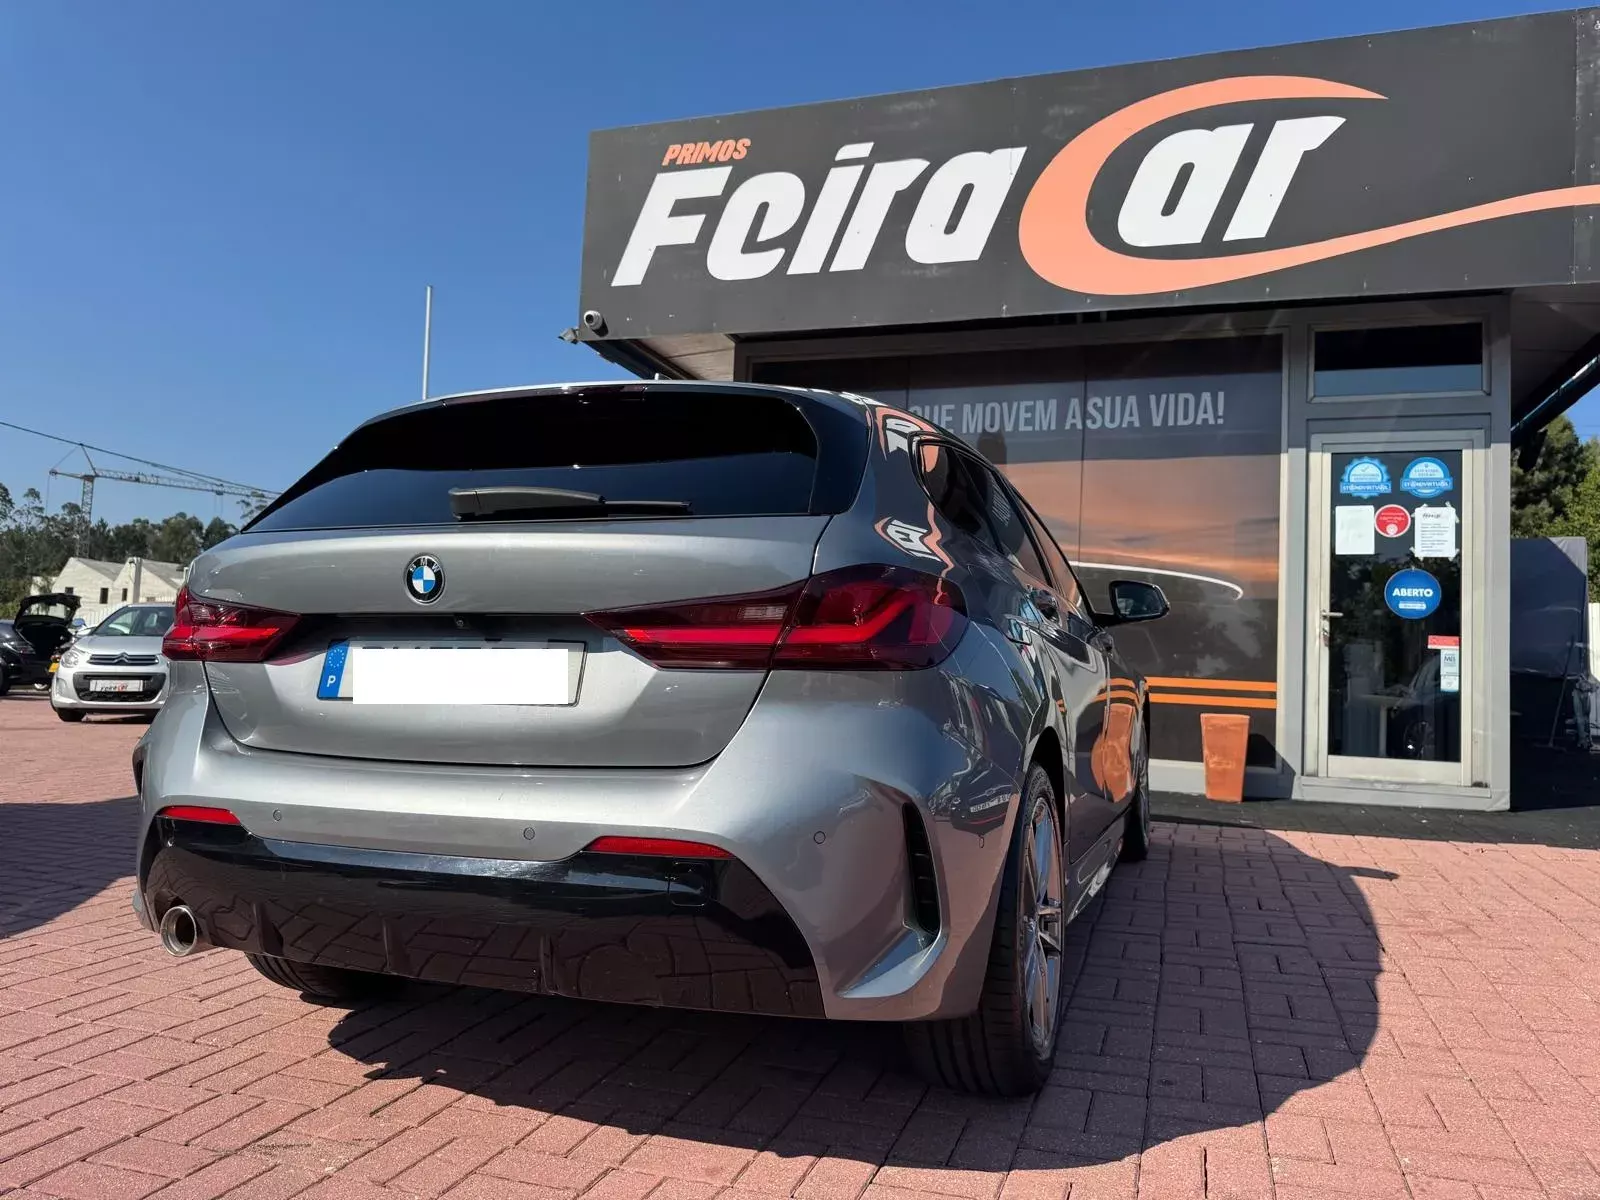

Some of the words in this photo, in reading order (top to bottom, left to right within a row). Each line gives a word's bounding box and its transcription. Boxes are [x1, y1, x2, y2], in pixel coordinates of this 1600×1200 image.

[661, 138, 752, 166] PRIMOS
[962, 399, 1057, 434] MOVEM
[1064, 397, 1083, 430] A
[1086, 394, 1140, 429] SUA
[1149, 391, 1226, 426] VIDA!
[410, 557, 440, 572] BMW
[1392, 587, 1434, 597] ABERTO
[326, 675, 336, 687] P
